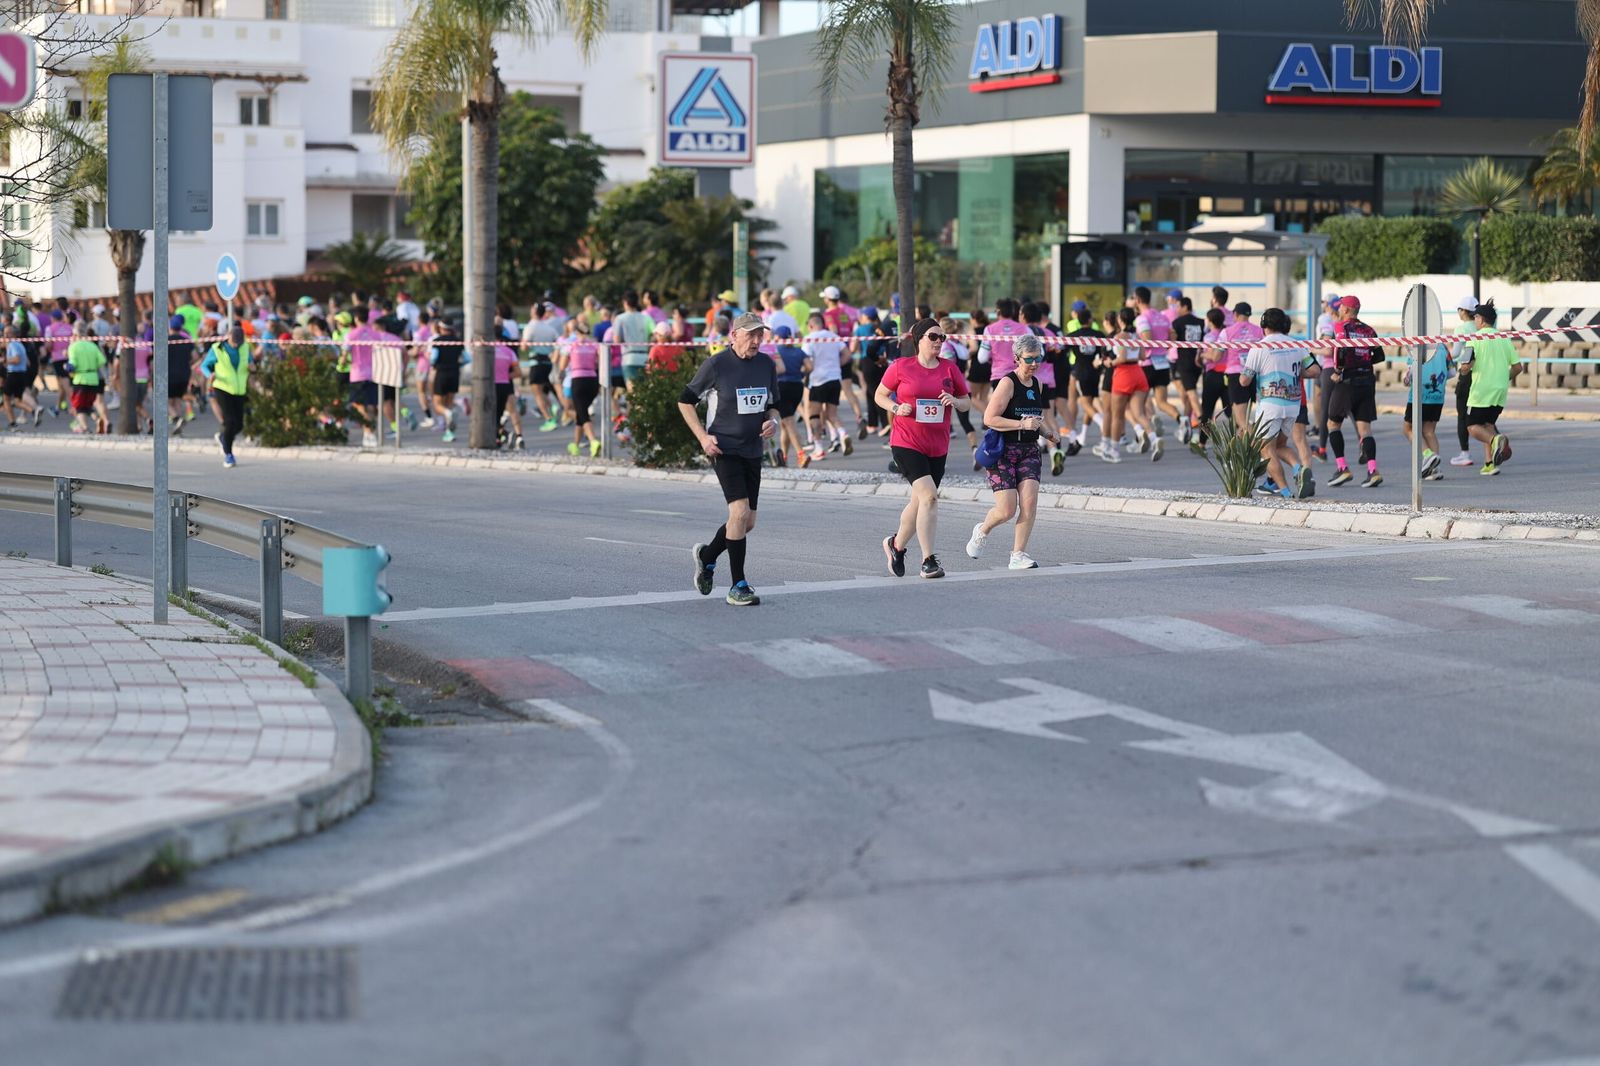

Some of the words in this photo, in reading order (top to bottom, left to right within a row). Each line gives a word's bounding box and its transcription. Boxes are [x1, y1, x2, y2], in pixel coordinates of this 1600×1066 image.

[968, 12, 1060, 80] ALDI
[1267, 43, 1443, 95] ALDI
[675, 133, 740, 150] ALDI
[743, 395, 763, 406] 167
[924, 406, 938, 416] 33
